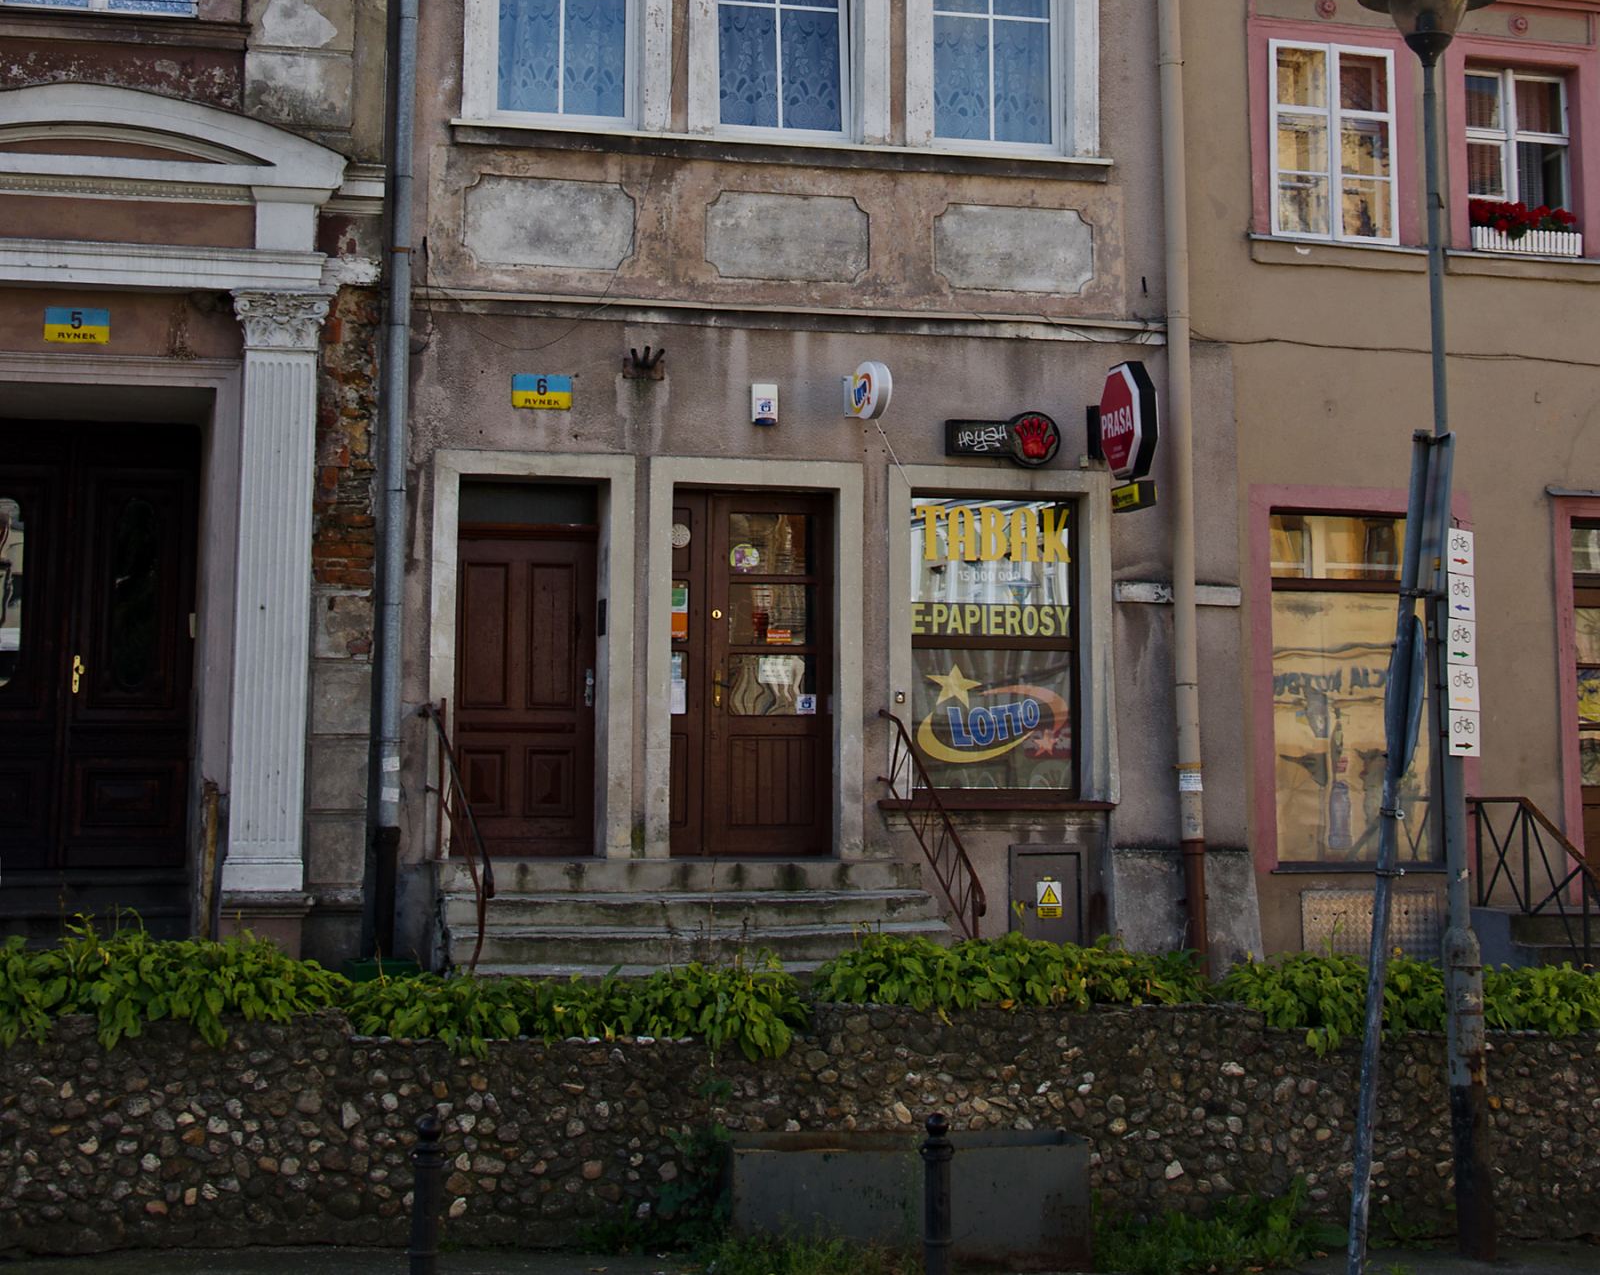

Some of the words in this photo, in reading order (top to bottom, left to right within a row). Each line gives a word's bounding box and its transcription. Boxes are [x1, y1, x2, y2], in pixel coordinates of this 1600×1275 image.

[71, 311, 82, 330] 5
[57, 332, 97, 340] RYNEK
[537, 378, 548, 396] 6
[524, 398, 560, 406] RYNEK
[1101, 405, 1133, 440] PRASA
[915, 505, 1071, 563] TABAK
[911, 603, 1071, 637] E-PAPIEROSY
[947, 698, 1040, 747] LOTTO
